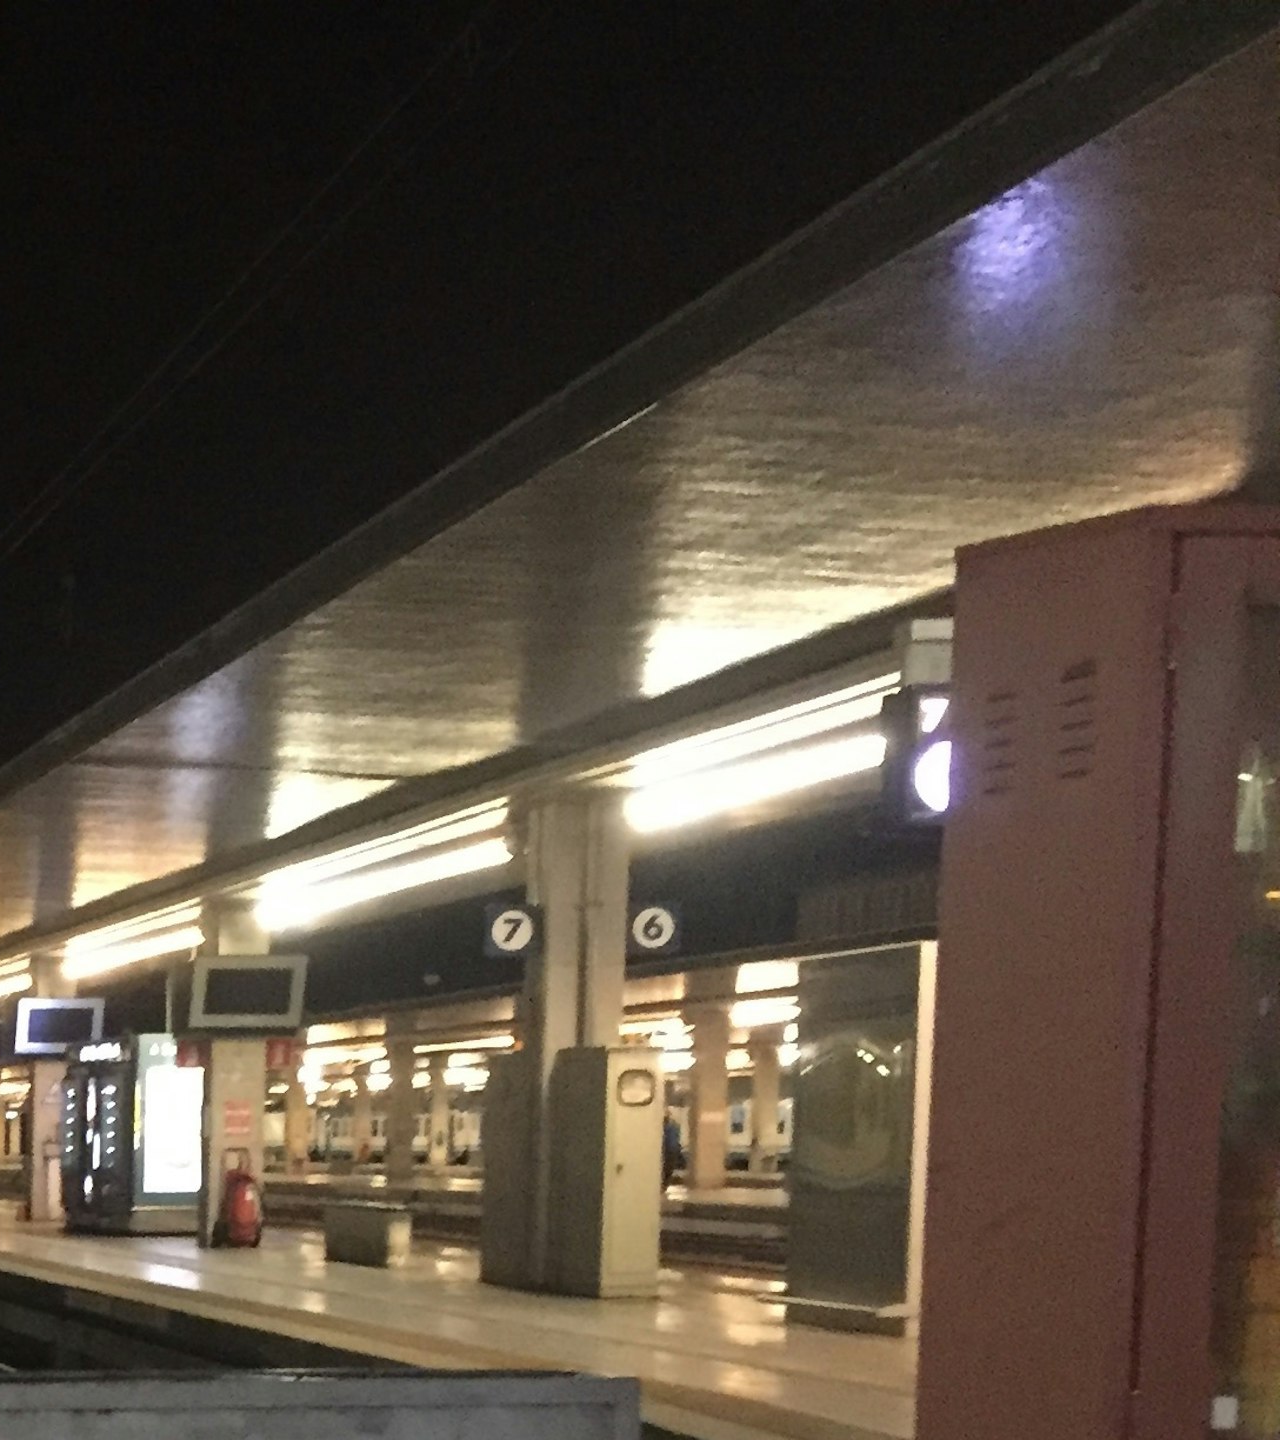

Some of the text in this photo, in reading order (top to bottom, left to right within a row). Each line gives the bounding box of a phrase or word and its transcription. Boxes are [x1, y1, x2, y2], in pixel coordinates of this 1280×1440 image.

[919, 697, 950, 734] 7
[502, 917, 524, 943] 7
[641, 913, 664, 941] 6
